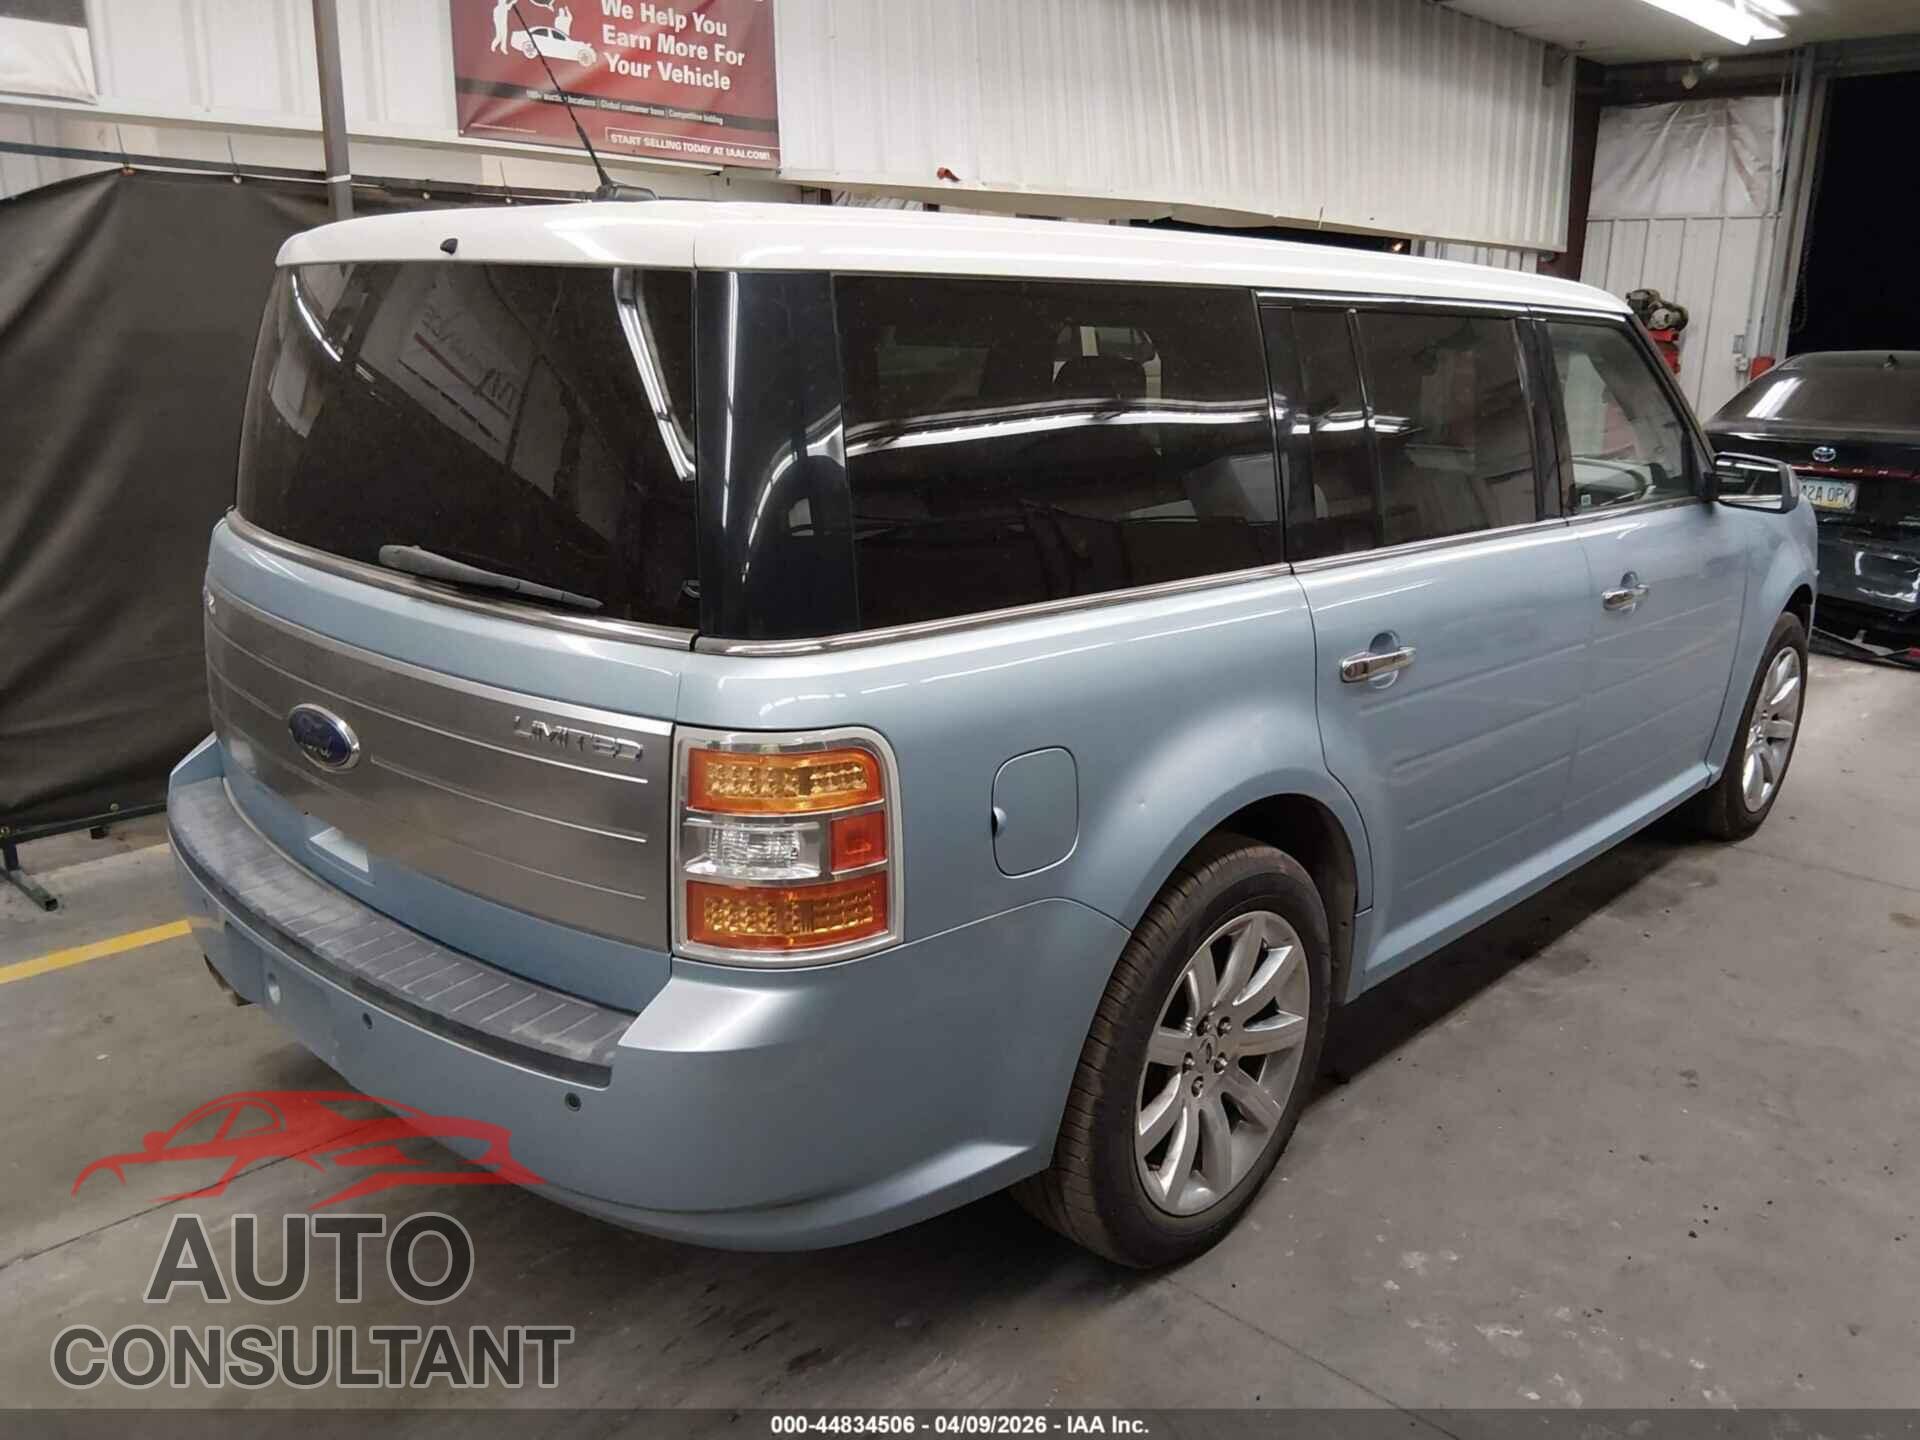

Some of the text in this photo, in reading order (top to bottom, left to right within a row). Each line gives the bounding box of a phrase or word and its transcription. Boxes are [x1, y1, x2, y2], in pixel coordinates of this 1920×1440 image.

[600, 0, 728, 37] We Help You
[602, 23, 745, 67] Earn More For
[603, 51, 731, 91] Your Vehicle
[610, 133, 642, 147] START
[643, 137, 682, 152] SELLING
[682, 142, 712, 155] TODAY
[712, 146, 726, 157] AT
[513, 715, 644, 761] LIMITED
